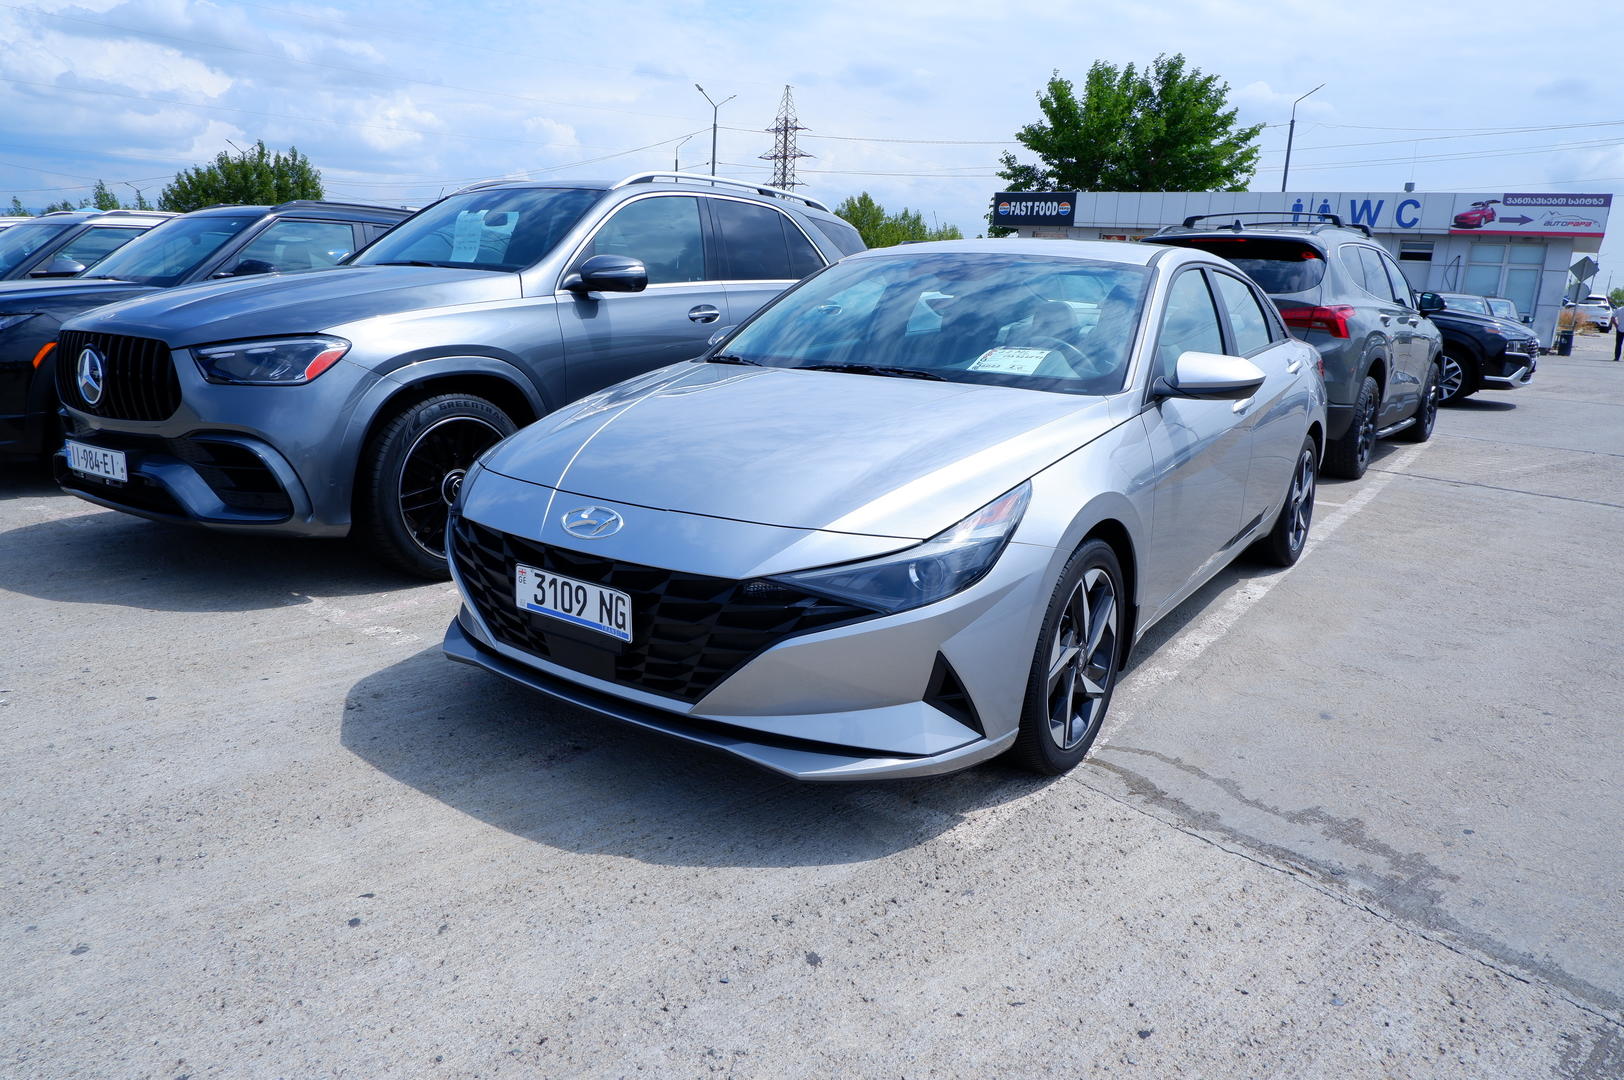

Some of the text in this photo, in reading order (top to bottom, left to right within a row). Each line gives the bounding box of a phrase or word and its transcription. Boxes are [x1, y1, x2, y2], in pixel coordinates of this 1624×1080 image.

[1010, 201, 1058, 216] FAST FOOD
[518, 575, 527, 584] GE
[534, 572, 626, 631] 3109 NG
